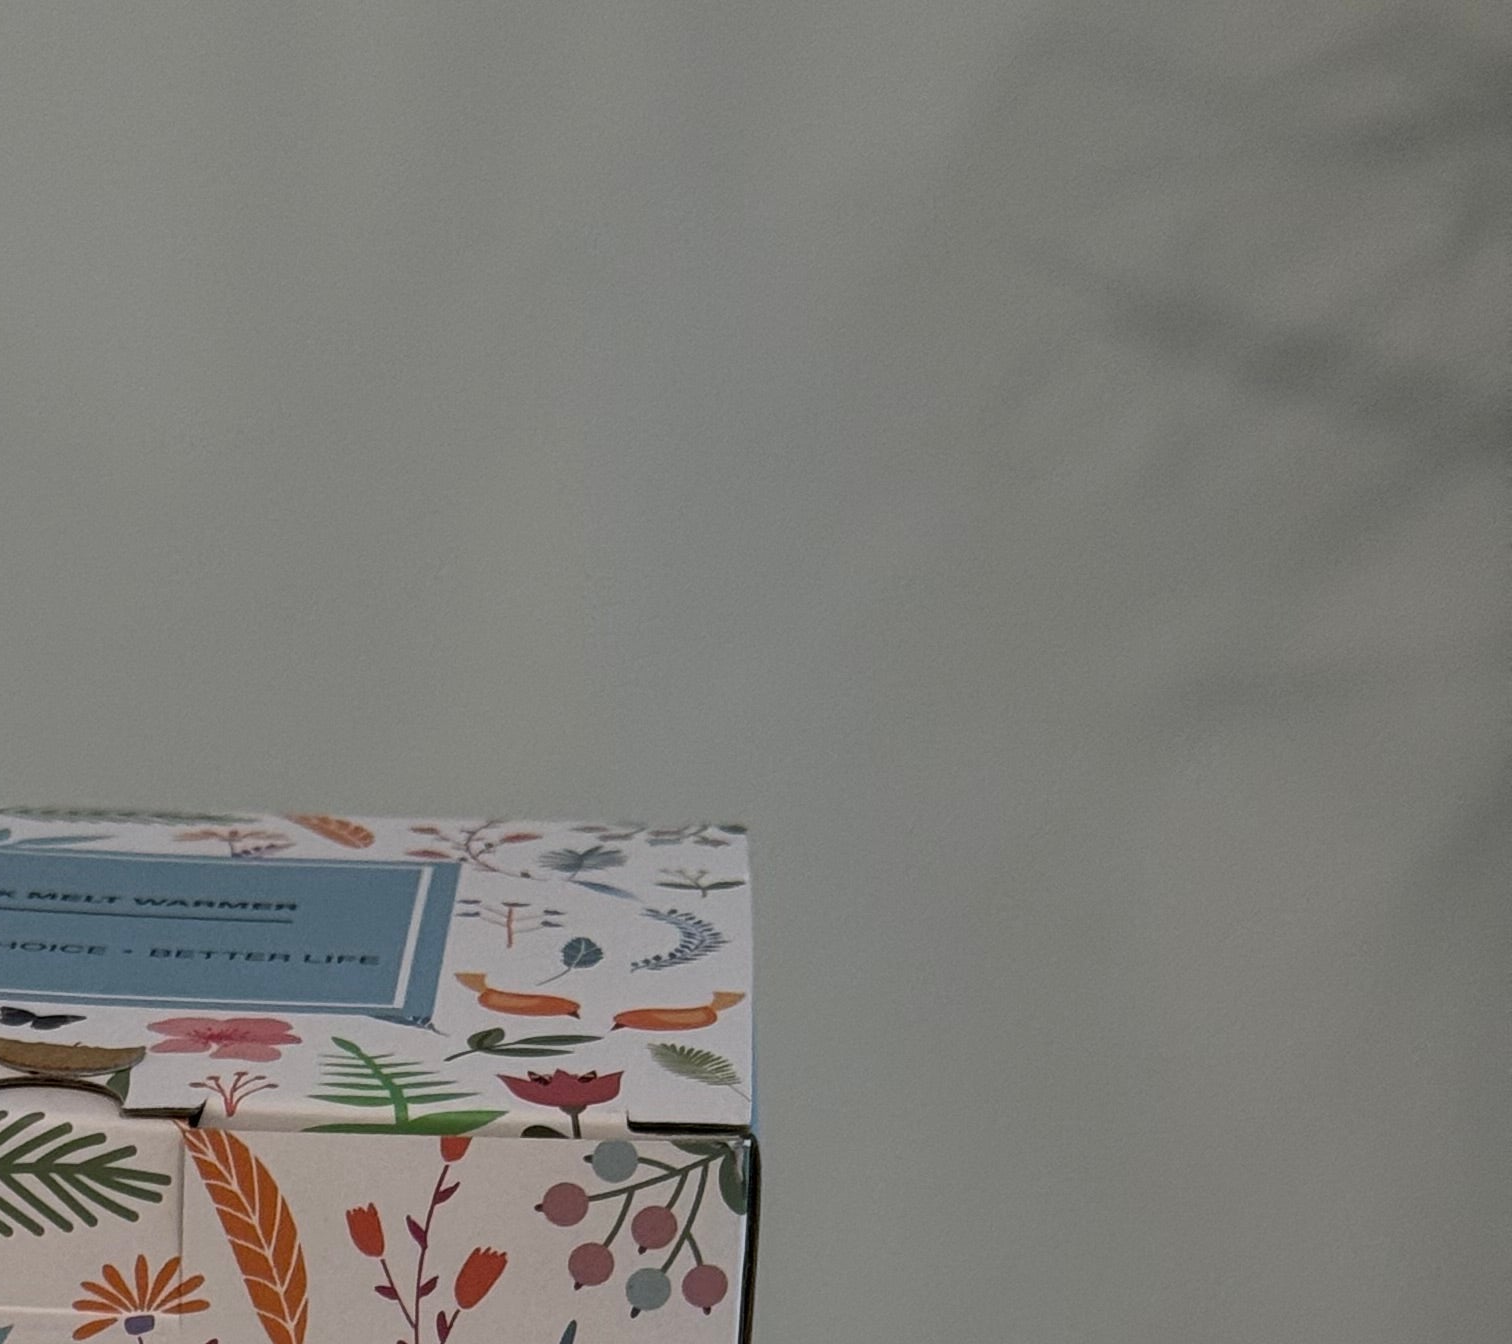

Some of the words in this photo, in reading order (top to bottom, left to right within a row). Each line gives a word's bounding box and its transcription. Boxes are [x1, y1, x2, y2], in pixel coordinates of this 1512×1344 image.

[27, 891, 121, 904] MELT
[133, 897, 298, 912] WARMER
[149, 948, 291, 963] BETTER
[303, 953, 378, 965] LIFE
